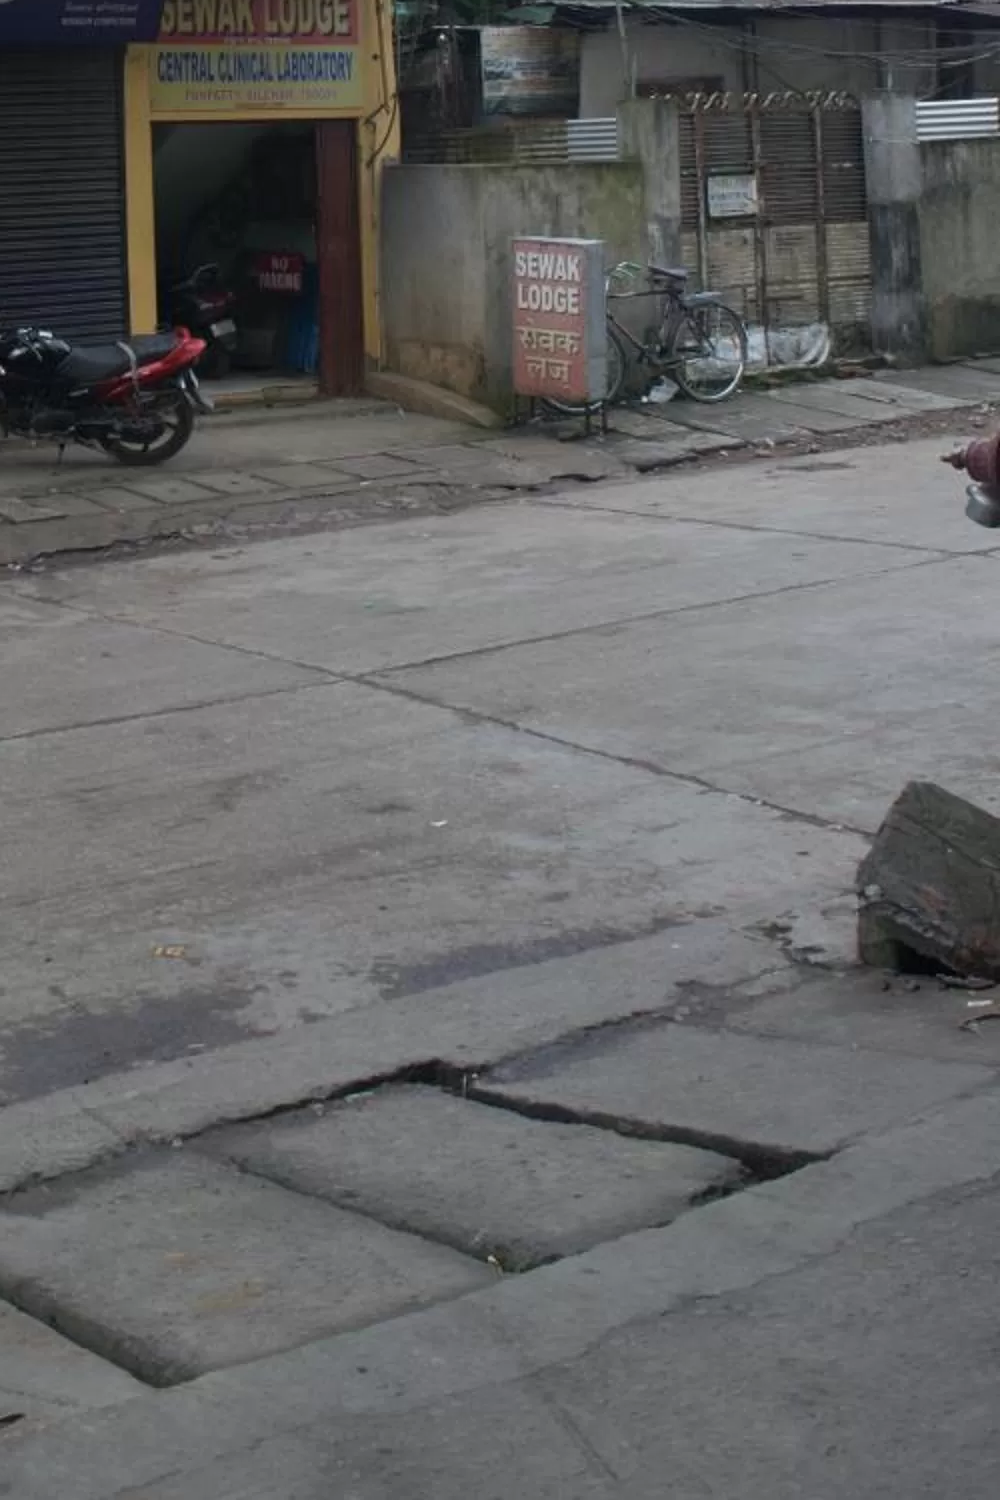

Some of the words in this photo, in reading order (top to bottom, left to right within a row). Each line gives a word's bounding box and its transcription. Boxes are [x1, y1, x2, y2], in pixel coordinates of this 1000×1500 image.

[156, 51, 214, 83] CENTRAL
[218, 51, 274, 83] CLINICAL
[277, 50, 353, 82] LABORATORY
[515, 252, 582, 282] SEWAK
[517, 283, 581, 315] LODGE
